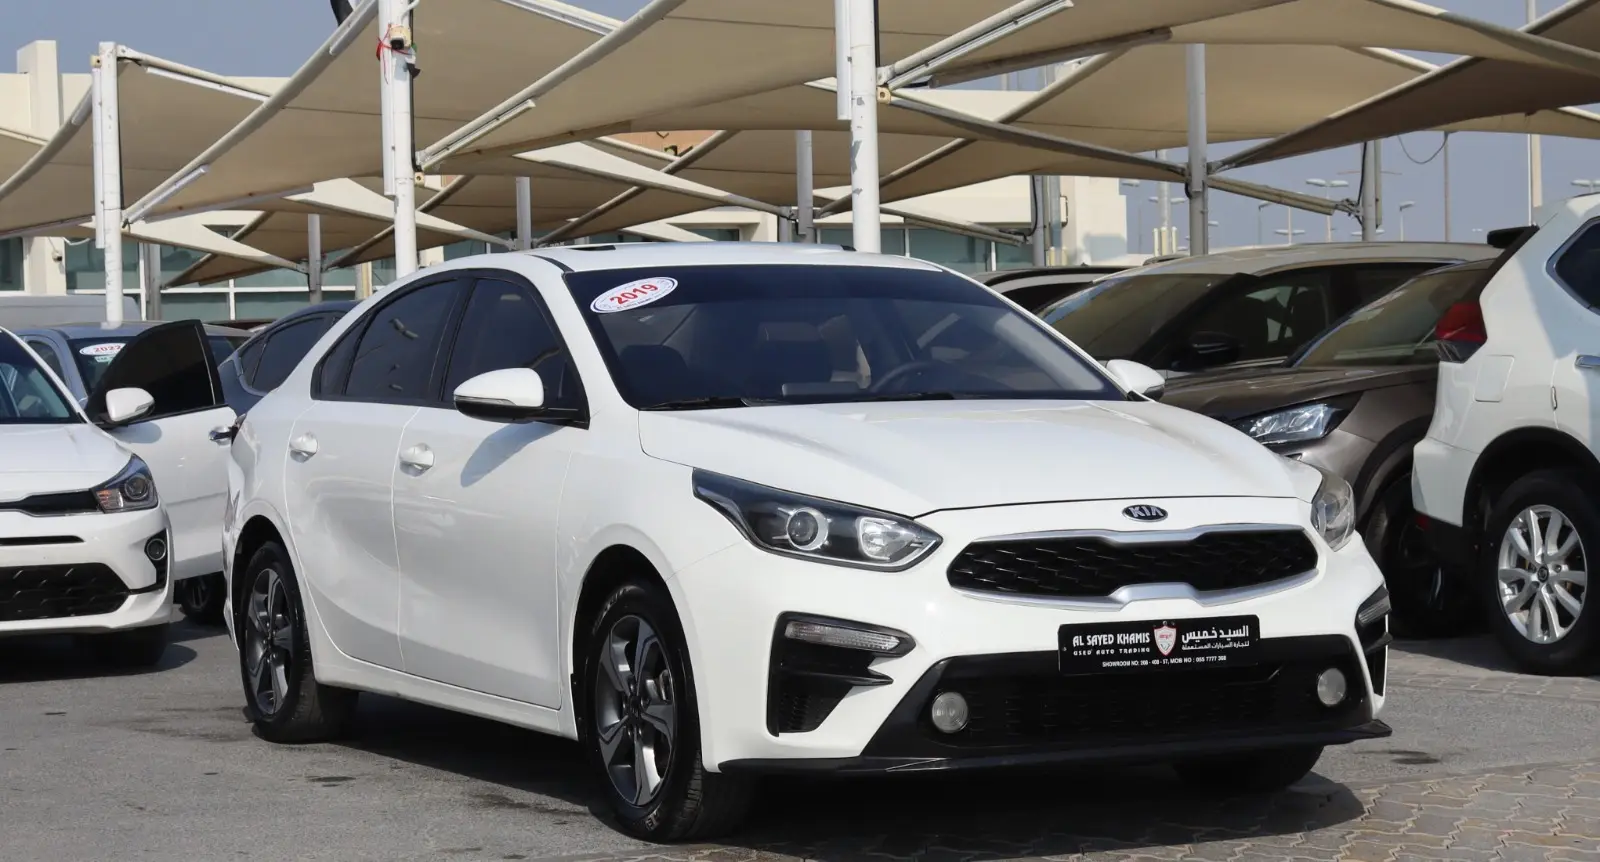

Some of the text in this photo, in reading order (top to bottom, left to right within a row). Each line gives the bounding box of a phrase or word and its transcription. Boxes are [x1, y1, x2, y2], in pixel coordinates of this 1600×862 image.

[609, 283, 659, 305] 2019
[1128, 505, 1164, 518] KIA
[1072, 635, 1085, 647] AL
[1086, 633, 1115, 647] SAYED
[1116, 632, 1151, 645] KHAMIS
[1181, 627, 1218, 643] خميس
[1219, 625, 1249, 641] السيد
